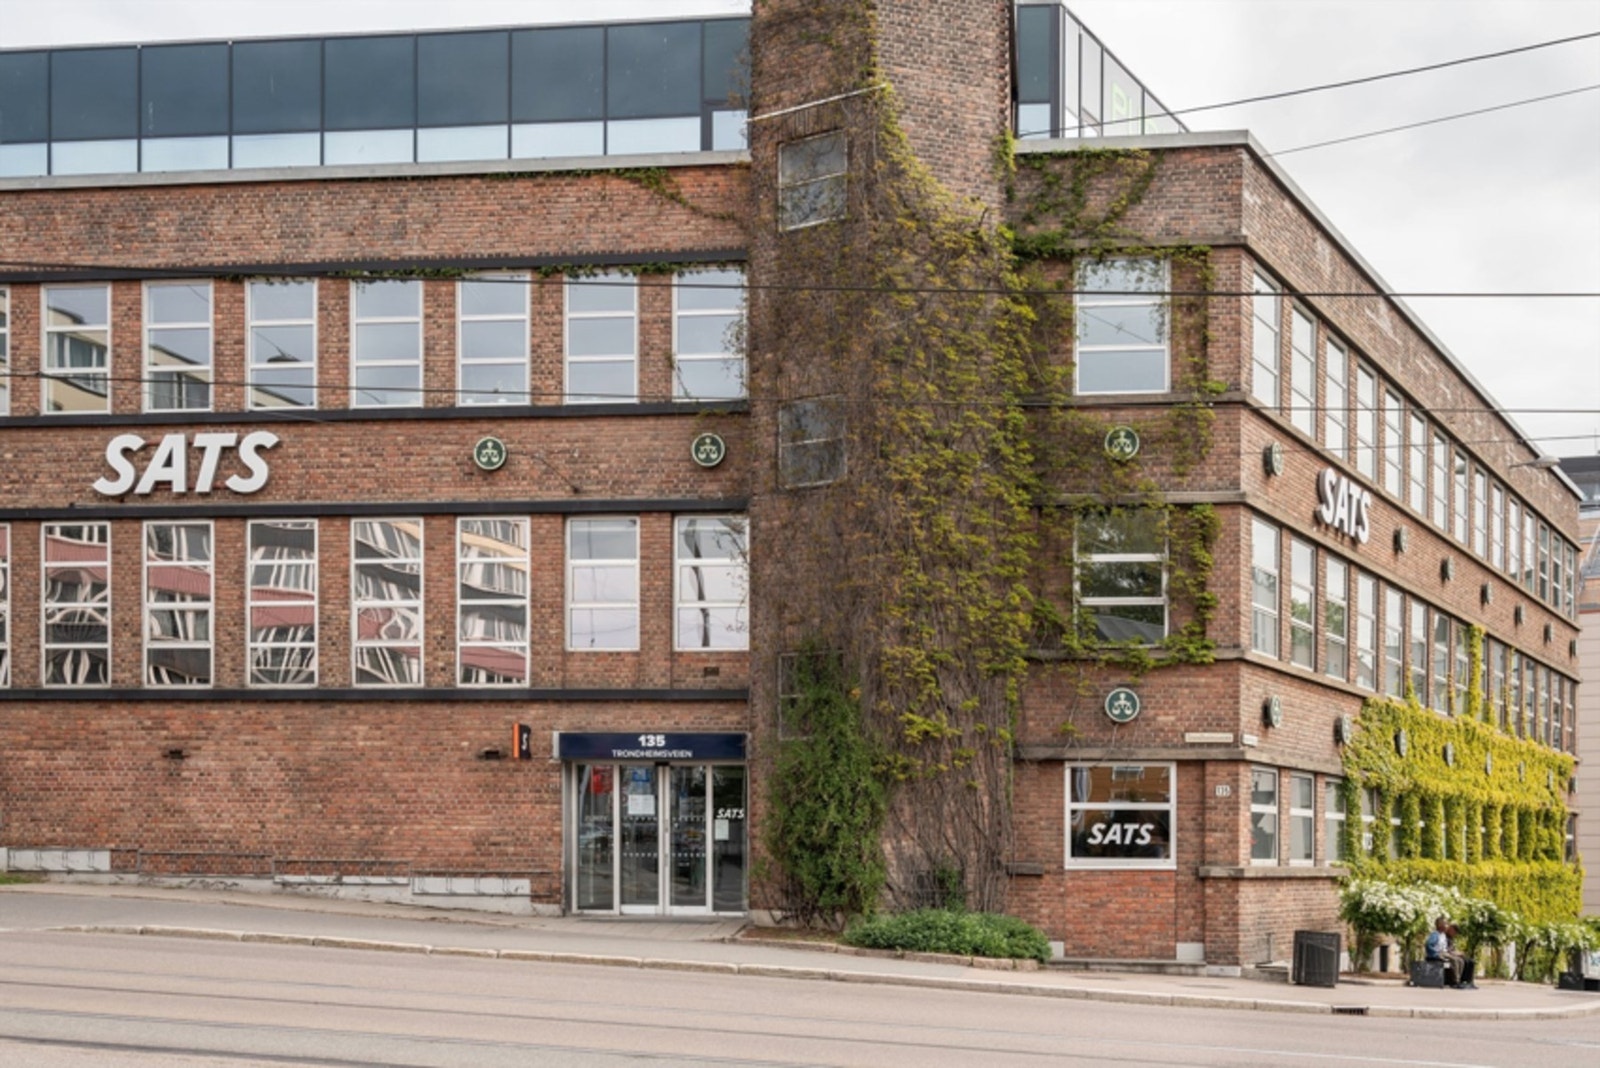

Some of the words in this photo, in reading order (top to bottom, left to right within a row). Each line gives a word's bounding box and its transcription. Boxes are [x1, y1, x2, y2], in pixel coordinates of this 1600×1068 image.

[92, 431, 280, 496] SATS
[1317, 467, 1371, 545] SATS
[638, 734, 666, 747] 135
[612, 749, 693, 758] TRONDHEIMSVEIEN
[716, 807, 744, 819] SATS
[1086, 822, 1154, 846] SATS
